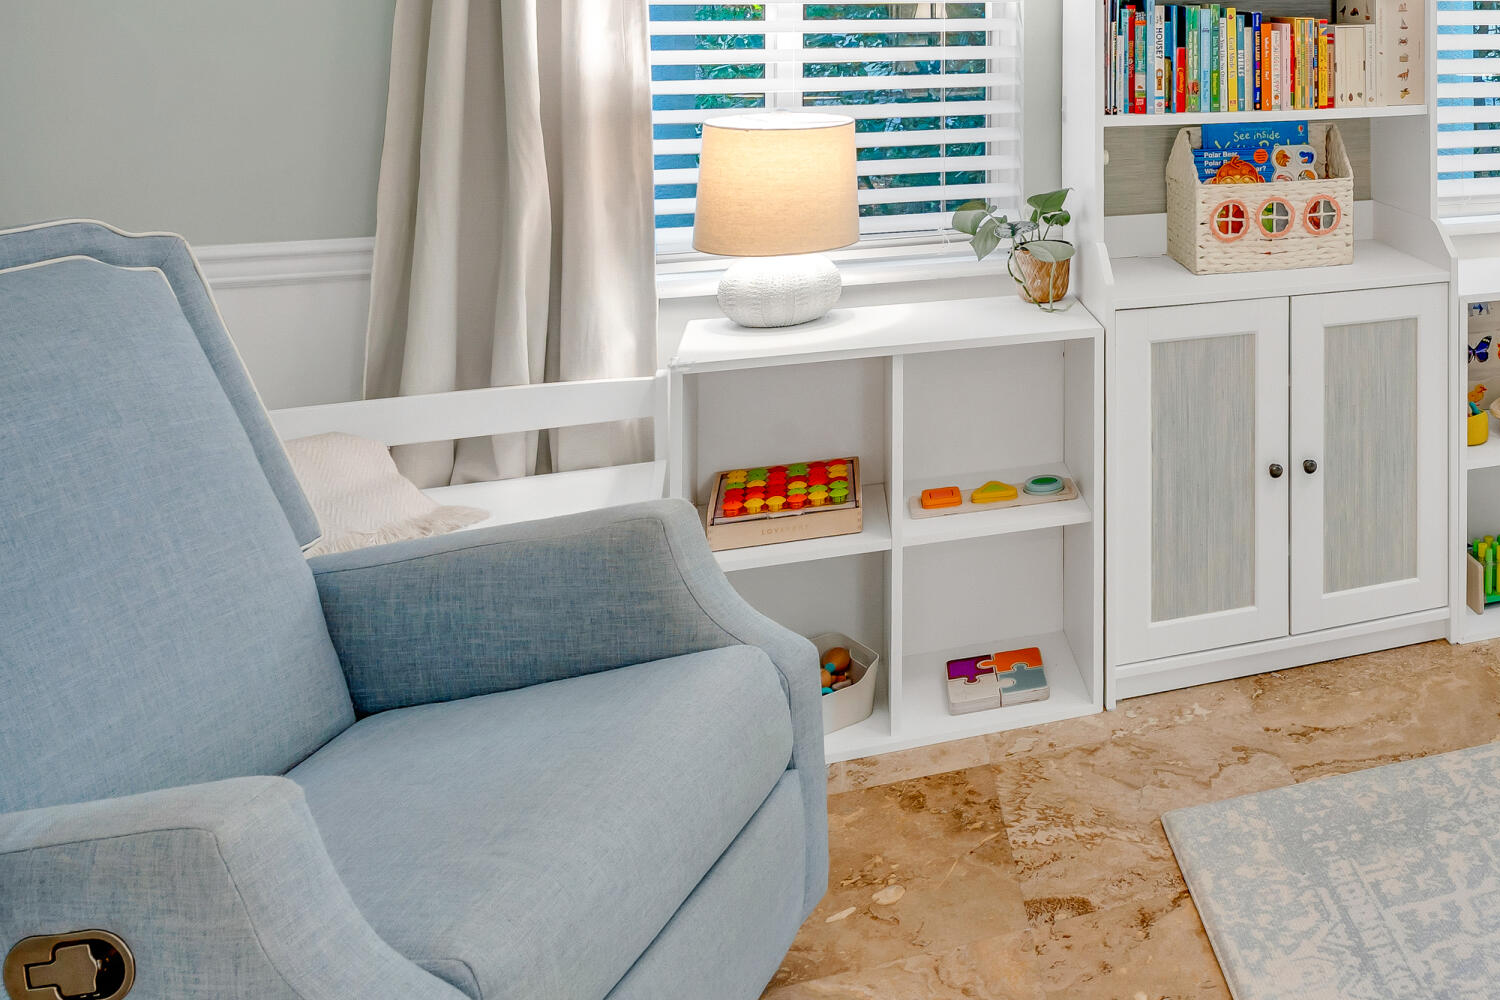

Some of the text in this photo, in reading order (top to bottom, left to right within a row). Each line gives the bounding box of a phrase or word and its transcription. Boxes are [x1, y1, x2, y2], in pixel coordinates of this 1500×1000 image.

[1155, 27, 1163, 60] HOUSE?
[1229, 70, 1236, 79] Us
[1233, 131, 1251, 142] See
[1203, 151, 1222, 159] Polar
